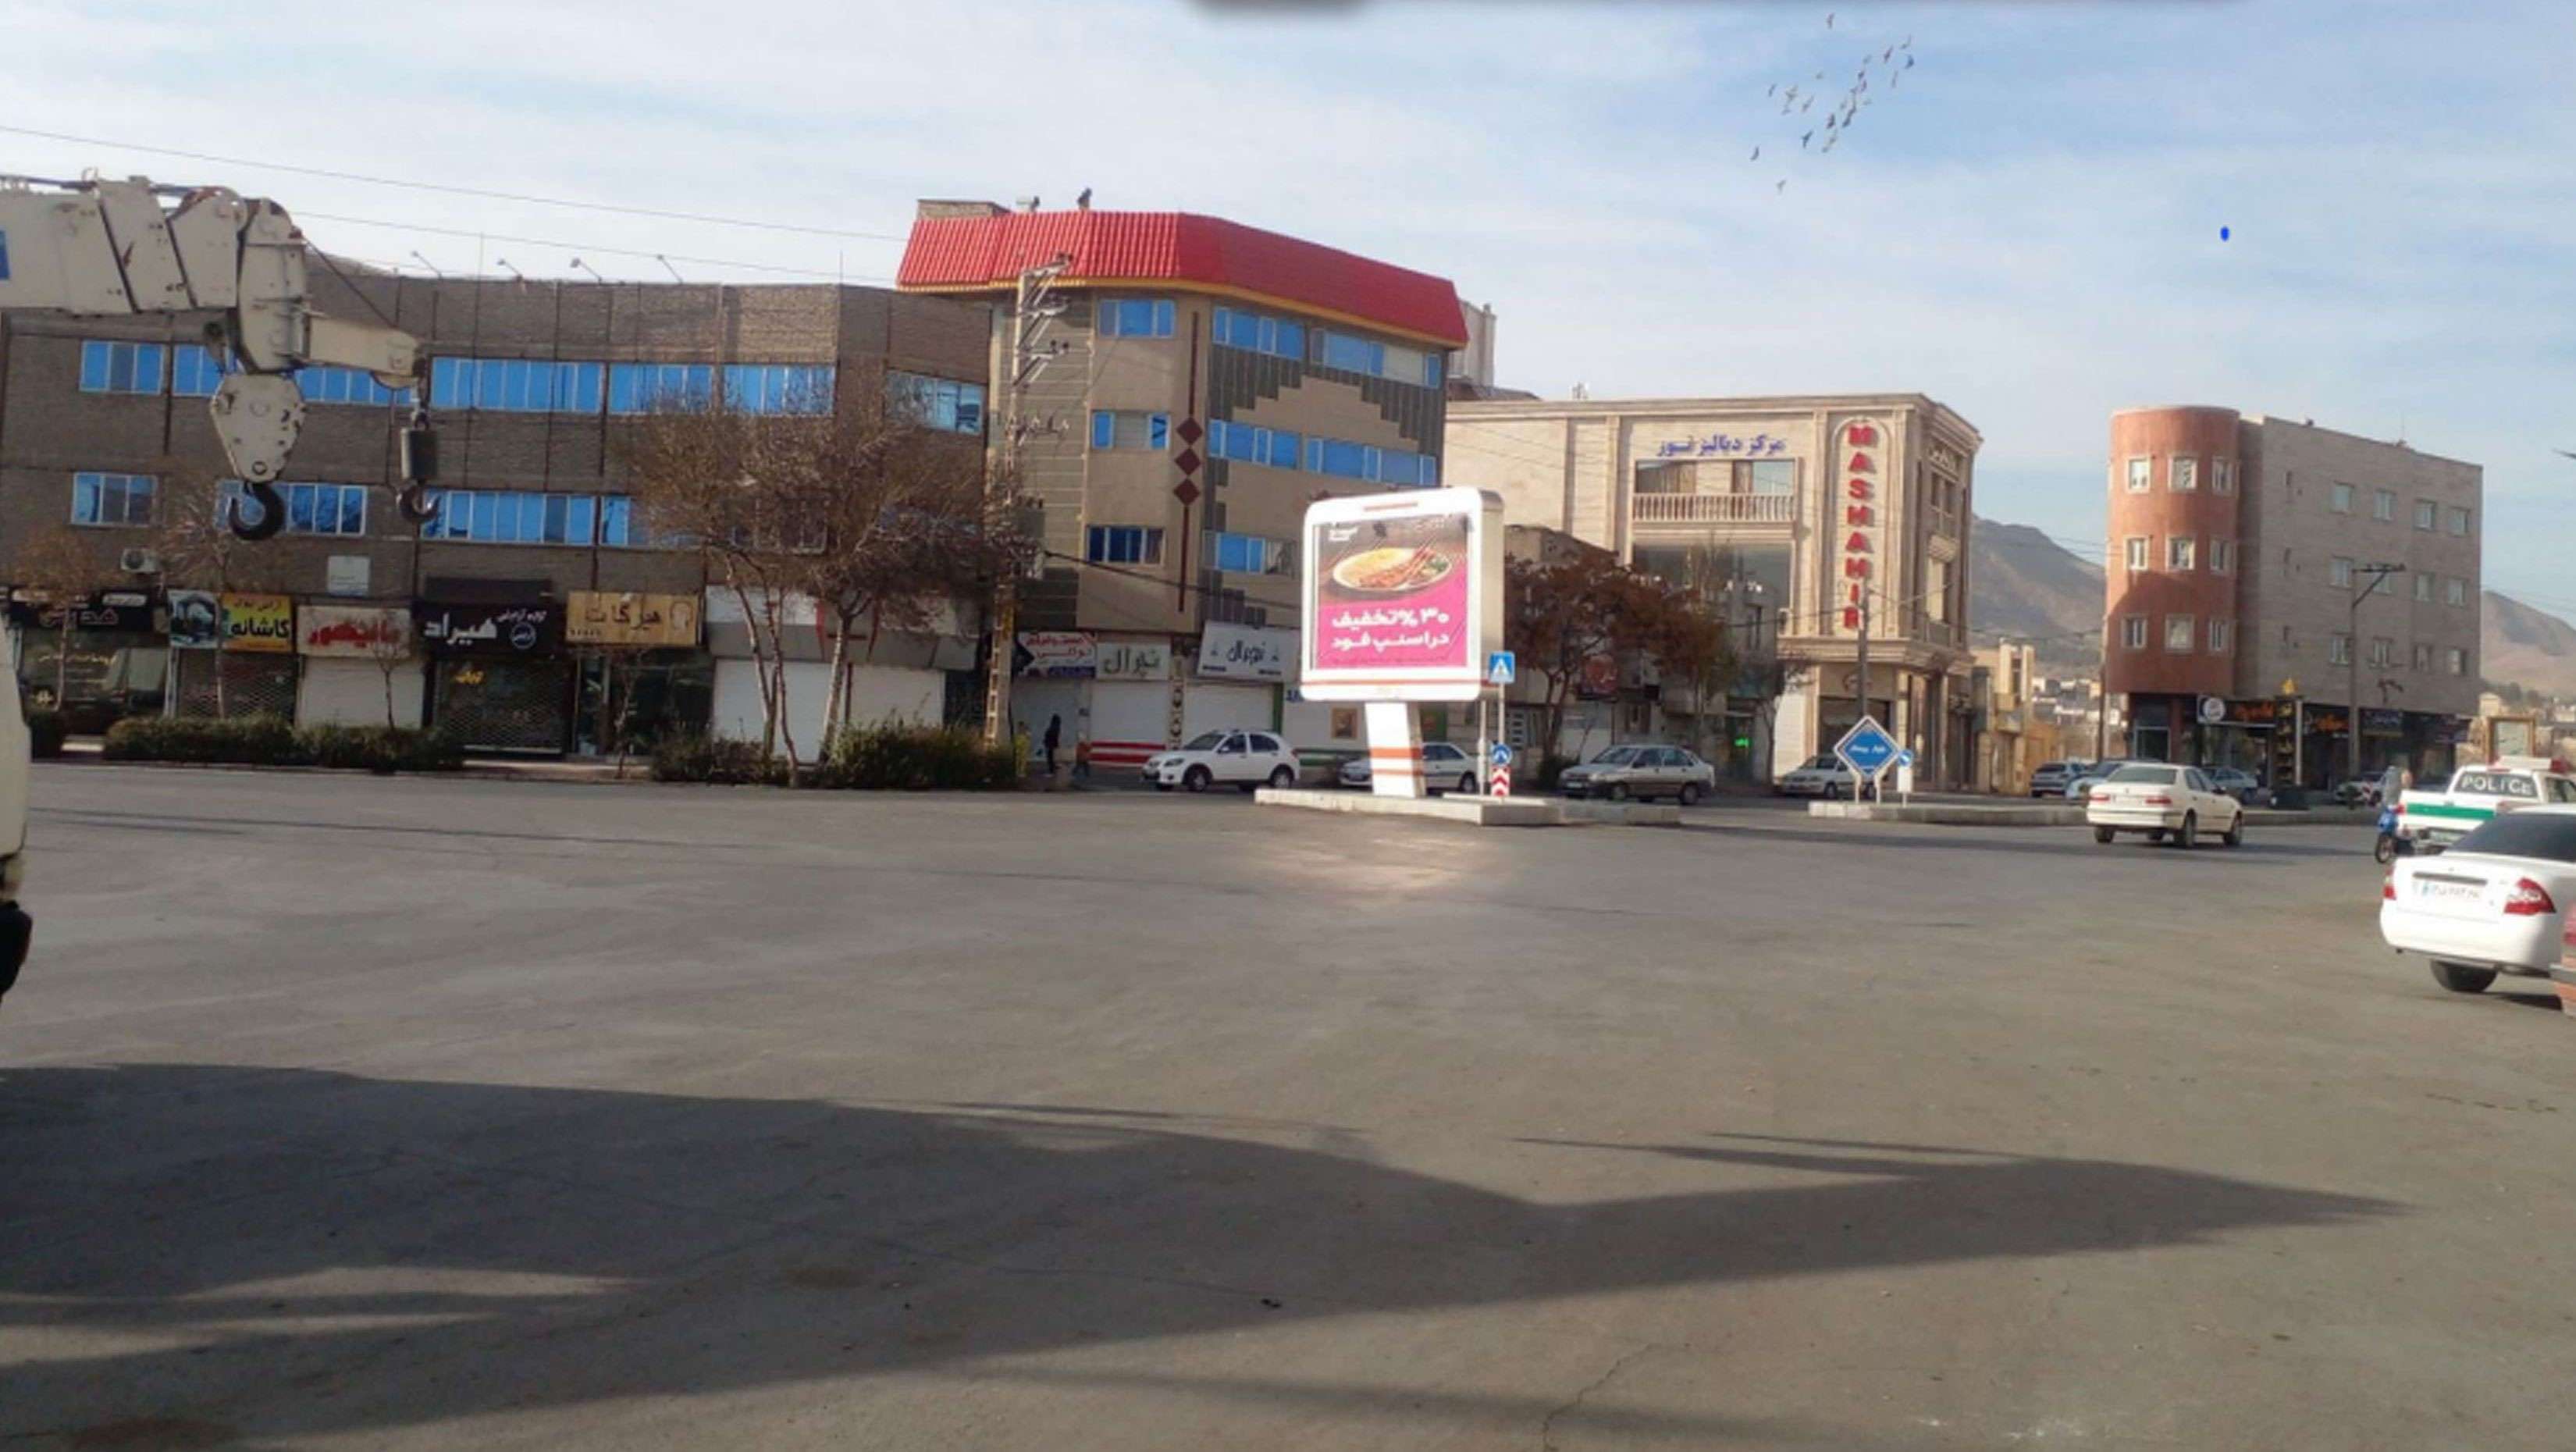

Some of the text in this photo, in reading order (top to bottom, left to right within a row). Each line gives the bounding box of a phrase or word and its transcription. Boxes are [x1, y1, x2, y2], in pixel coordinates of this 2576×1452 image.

[1697, 432, 1743, 457] دیالیز
[1746, 432, 1786, 457] مرکز
[231, 617, 289, 638] کاشانه
[423, 612, 498, 646] هیراد
[2461, 774, 2533, 795] POLICE
